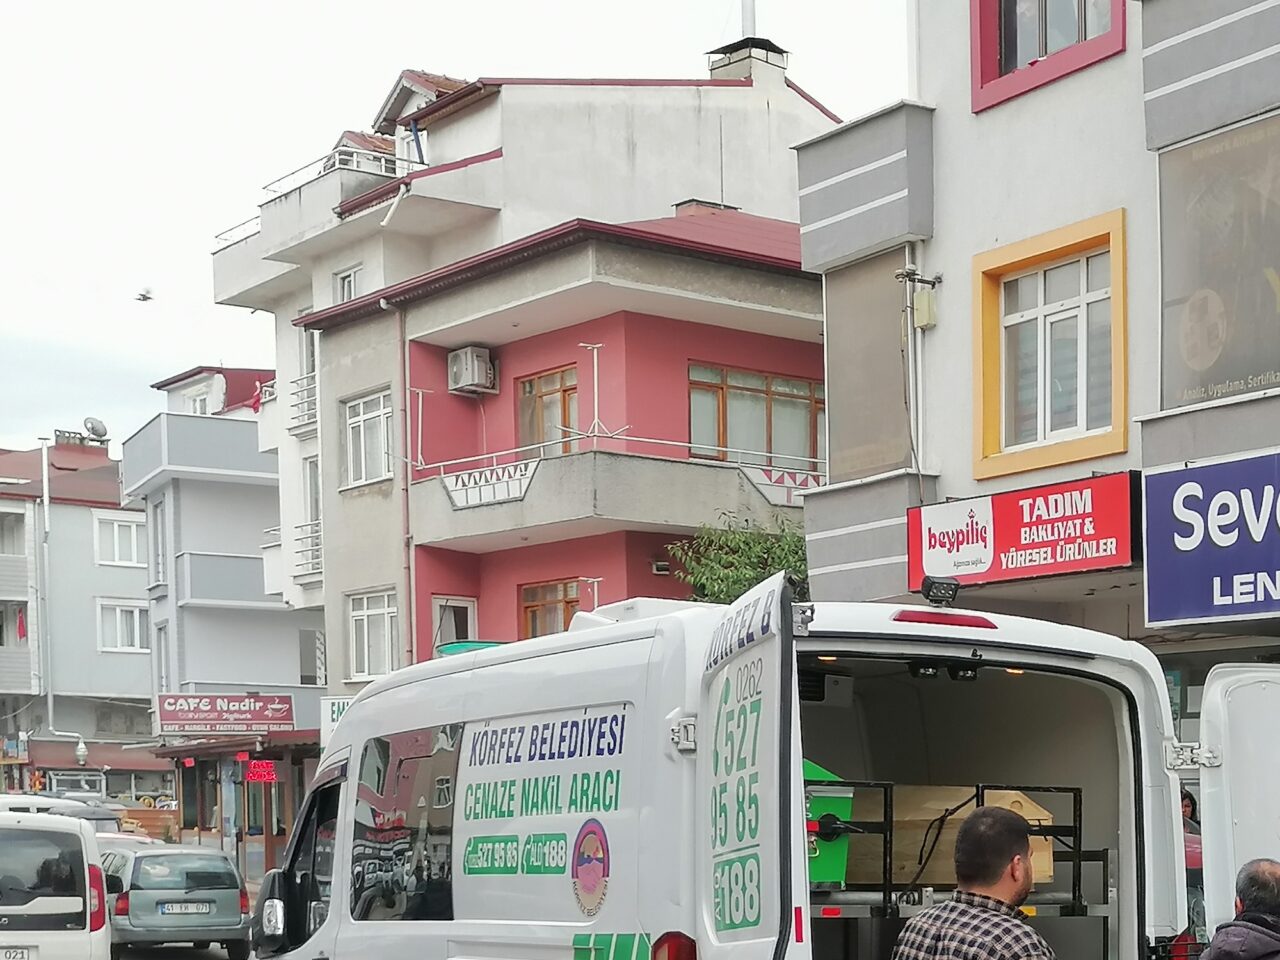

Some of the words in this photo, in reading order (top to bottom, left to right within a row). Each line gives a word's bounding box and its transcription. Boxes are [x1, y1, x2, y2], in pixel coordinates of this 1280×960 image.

[1019, 488, 1092, 523] TADIM
[1084, 517, 1095, 535] &
[1000, 546, 1055, 570] YÖRESEL
[1056, 537, 1117, 567] ÜRÜNLER
[736, 657, 763, 704] 0262
[164, 698, 211, 711] CAFE
[216, 697, 263, 711] Nadir
[469, 721, 526, 767] KÖRFEZ
[528, 702, 627, 762] BELEDİYESİ
[724, 698, 762, 777] 527
[464, 779, 516, 821] CENAZE
[568, 769, 621, 813] ARACI
[711, 782, 728, 850] 95
[736, 771, 759, 842] 85
[478, 842, 492, 868] 527
[506, 841, 518, 867] 85
[543, 840, 566, 867] 188
[721, 857, 760, 925] 188
